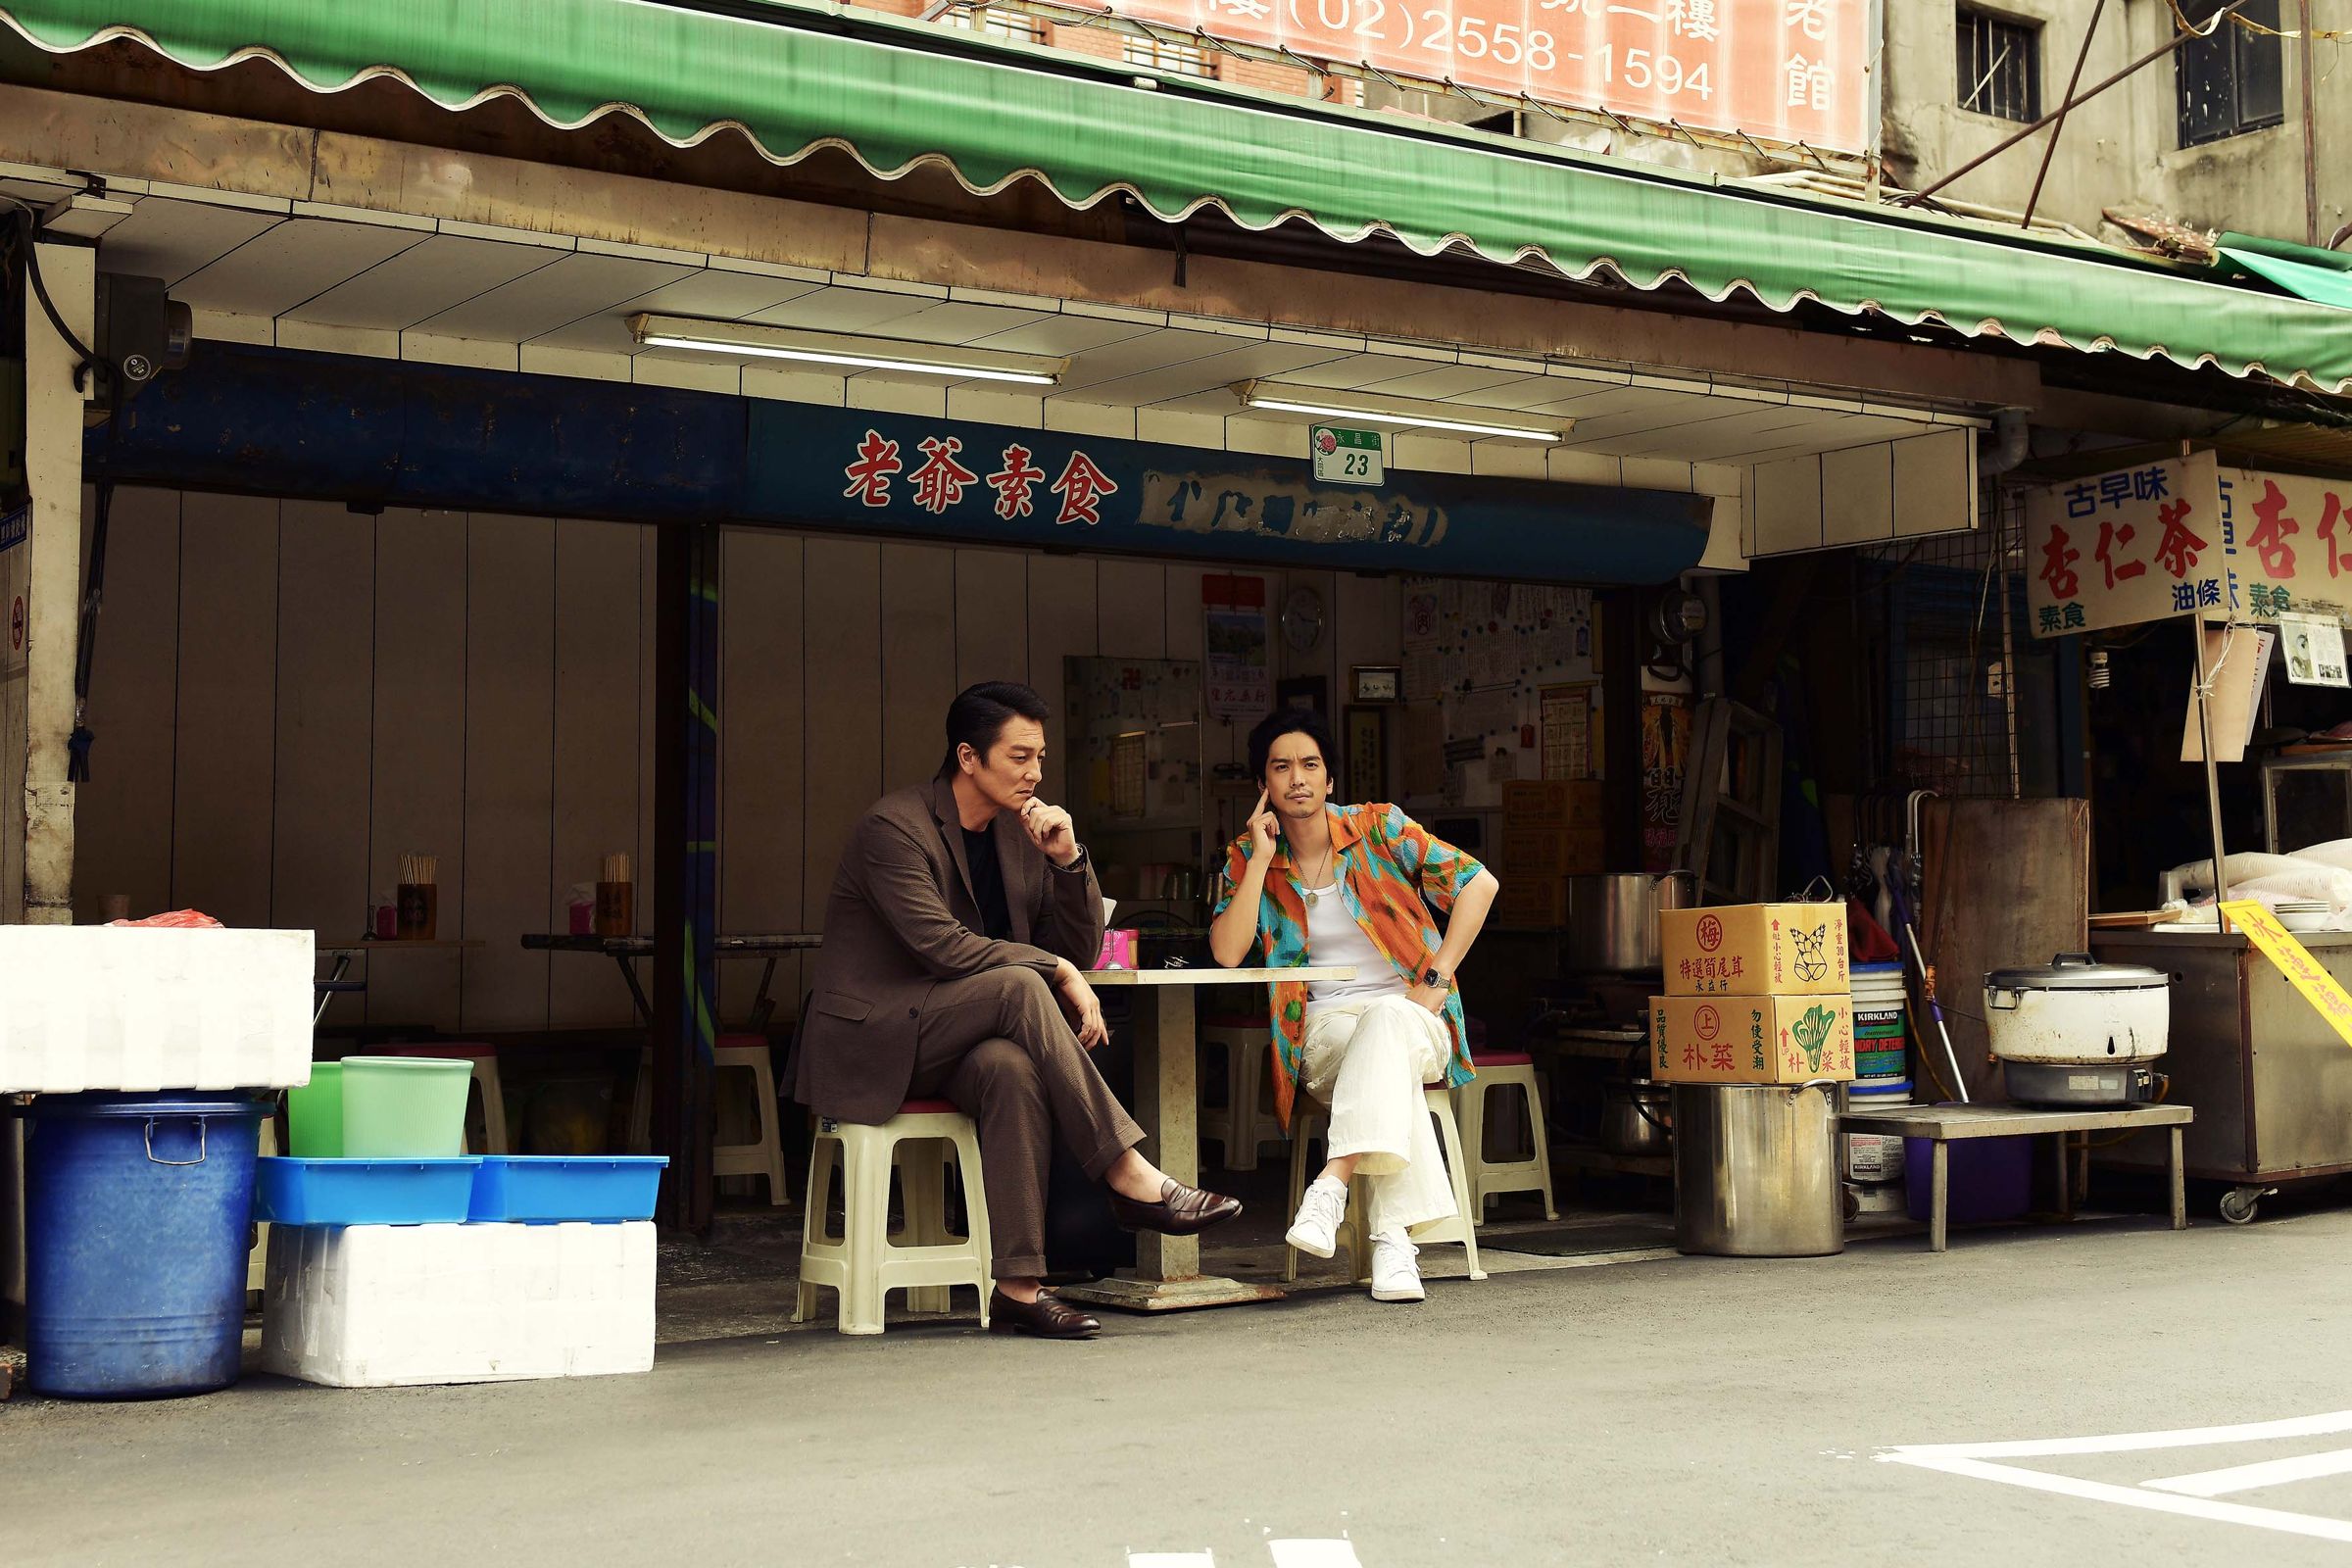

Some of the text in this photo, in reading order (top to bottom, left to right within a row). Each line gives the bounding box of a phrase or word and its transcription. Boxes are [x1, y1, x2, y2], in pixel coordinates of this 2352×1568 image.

[1289, 0, 1713, 101] (02)2558-1594
[844, 429, 1118, 525] 老爺素食
[1344, 453, 1369, 476] 23
[2064, 466, 2169, 518] 古早味
[2038, 498, 2208, 600] 杏仁茶
[2172, 578, 2221, 612] 油條
[2249, 582, 2291, 618] 素食
[2038, 601, 2086, 630] 素食
[1699, 919, 1720, 947] 梅
[1834, 918, 1845, 983] 淨重30台斤
[1695, 979, 1728, 993] 永益行
[1701, 1013, 1714, 1030] 上
[1857, 1011, 1898, 1022] KIRKLAND
[1656, 1008, 1669, 1069] 品質優良
[1750, 1008, 1765, 1070] 勿使受潮
[1838, 1006, 1851, 1070] 小心輕放
[1682, 1043, 1736, 1071] 朴菜
[1821, 1050, 1837, 1072] 菜
